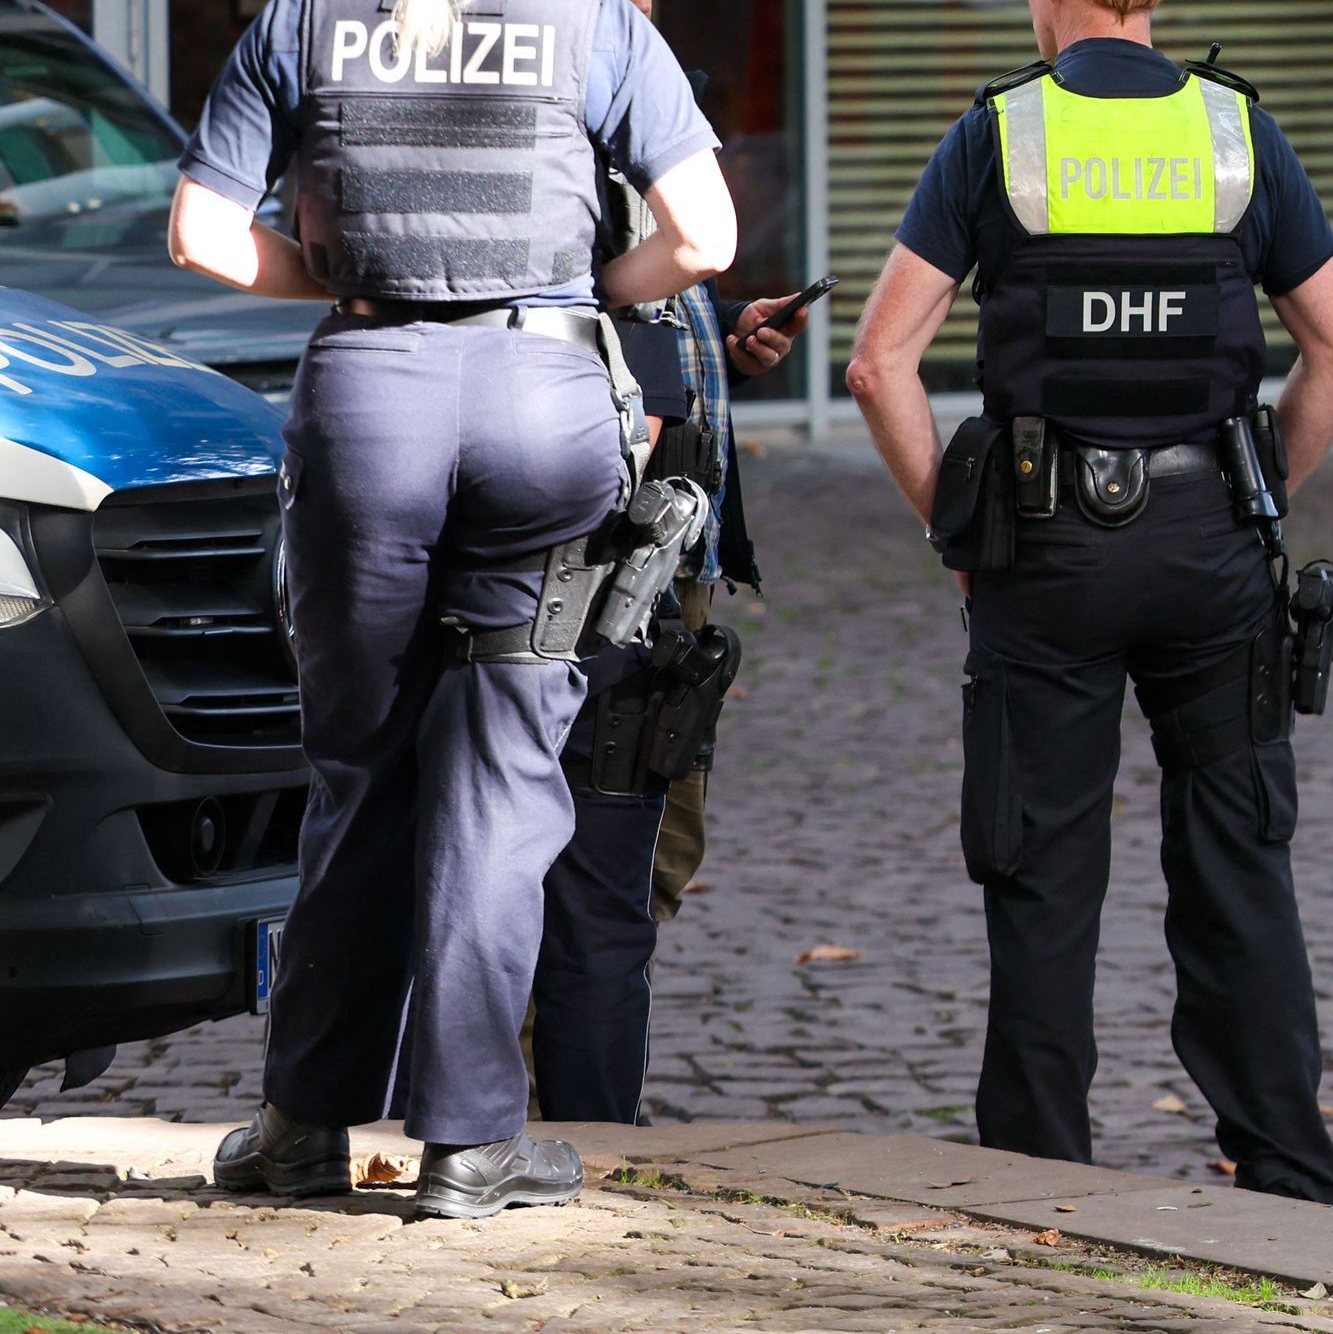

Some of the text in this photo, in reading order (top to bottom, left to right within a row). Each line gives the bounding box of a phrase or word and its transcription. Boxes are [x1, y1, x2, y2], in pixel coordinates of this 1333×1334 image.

[331, 20, 556, 86] POLIZEI
[1059, 157, 1202, 200] POLIZEI
[1082, 291, 1186, 332] DHF
